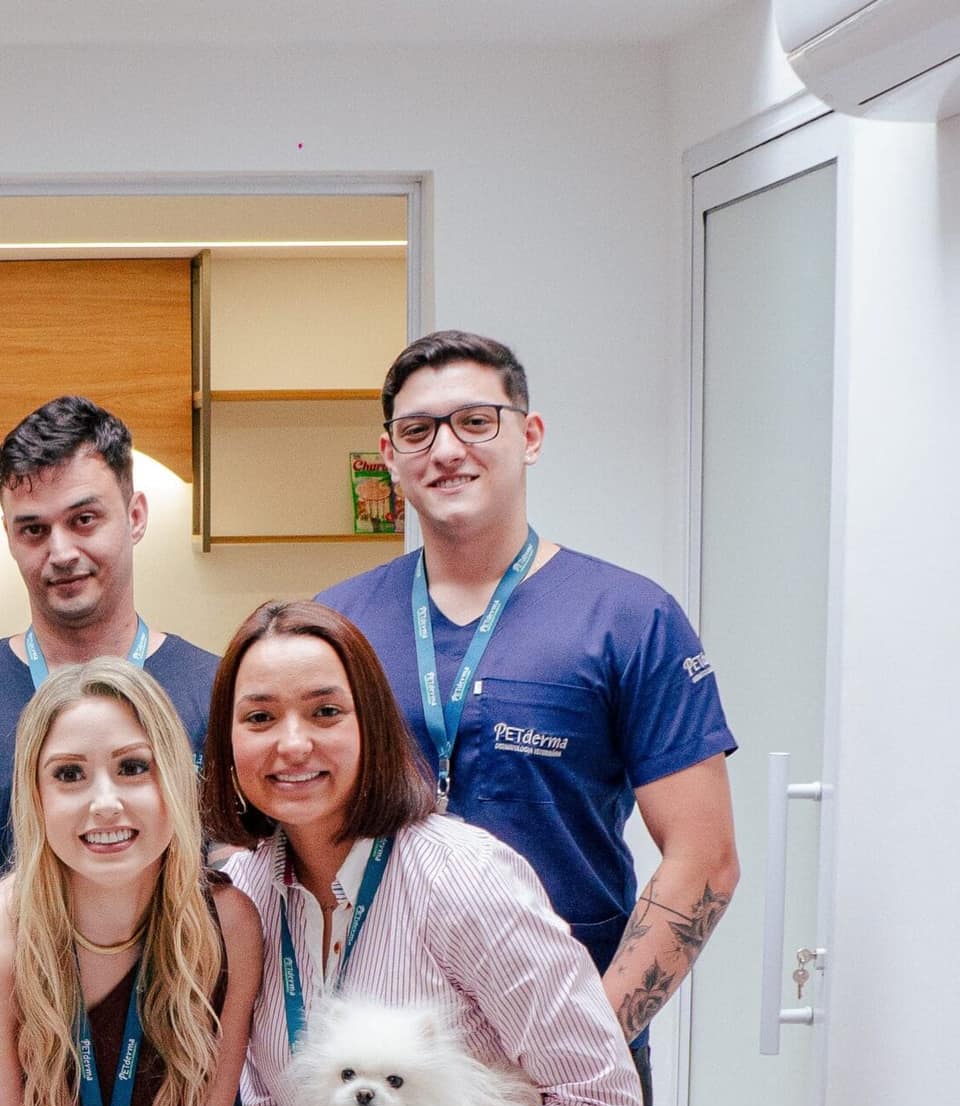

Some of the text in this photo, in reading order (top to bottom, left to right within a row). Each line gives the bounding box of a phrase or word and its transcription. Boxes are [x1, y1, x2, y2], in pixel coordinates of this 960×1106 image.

[494, 722, 569, 750] PETderma
[80, 1039, 94, 1081] PETderma
[118, 1039, 136, 1081] PETderma
